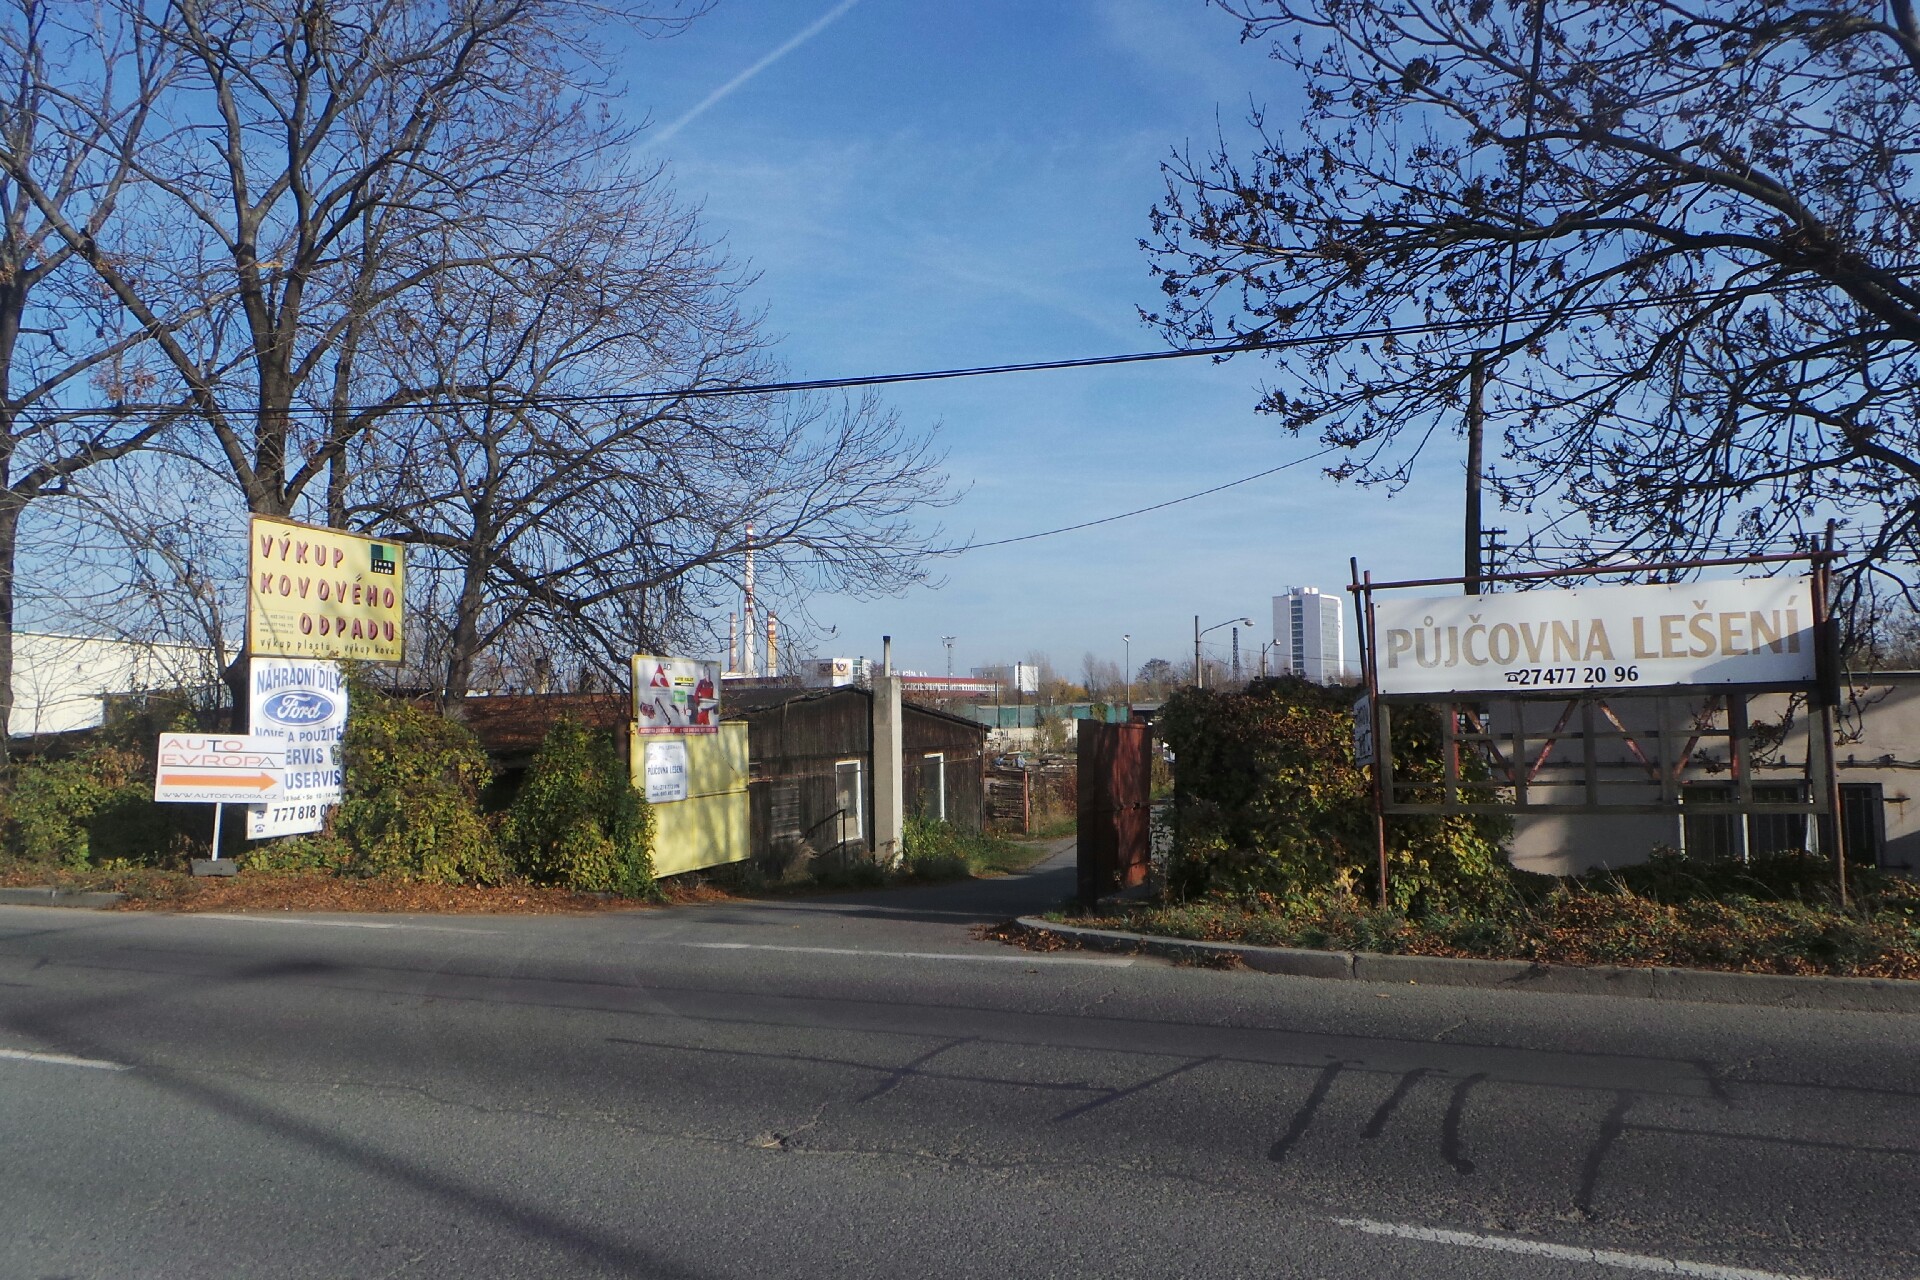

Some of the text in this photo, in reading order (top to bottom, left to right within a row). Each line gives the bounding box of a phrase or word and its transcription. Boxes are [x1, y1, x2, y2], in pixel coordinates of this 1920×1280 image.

[260, 530, 344, 568] VÝKUP
[260, 572, 395, 608] KOVOVÉHO
[299, 612, 395, 641] ODPADU
[1387, 595, 1799, 668] PŮJČOVNA LEŠENÍ
[260, 637, 291, 649] výkup
[256, 662, 342, 695] NÁHRADNÍ DÍLY
[1519, 665, 1639, 685] 27477 20 96
[277, 695, 321, 718] Ford
[287, 731, 295, 742] A
[299, 722, 343, 742] POUŽITÉ
[164, 738, 243, 752] AUTO
[161, 753, 276, 768] EVROPA
[286, 747, 324, 766] ERVIS
[285, 769, 341, 790] USERVIS
[273, 806, 295, 822] 777
[298, 804, 316, 820] 818
